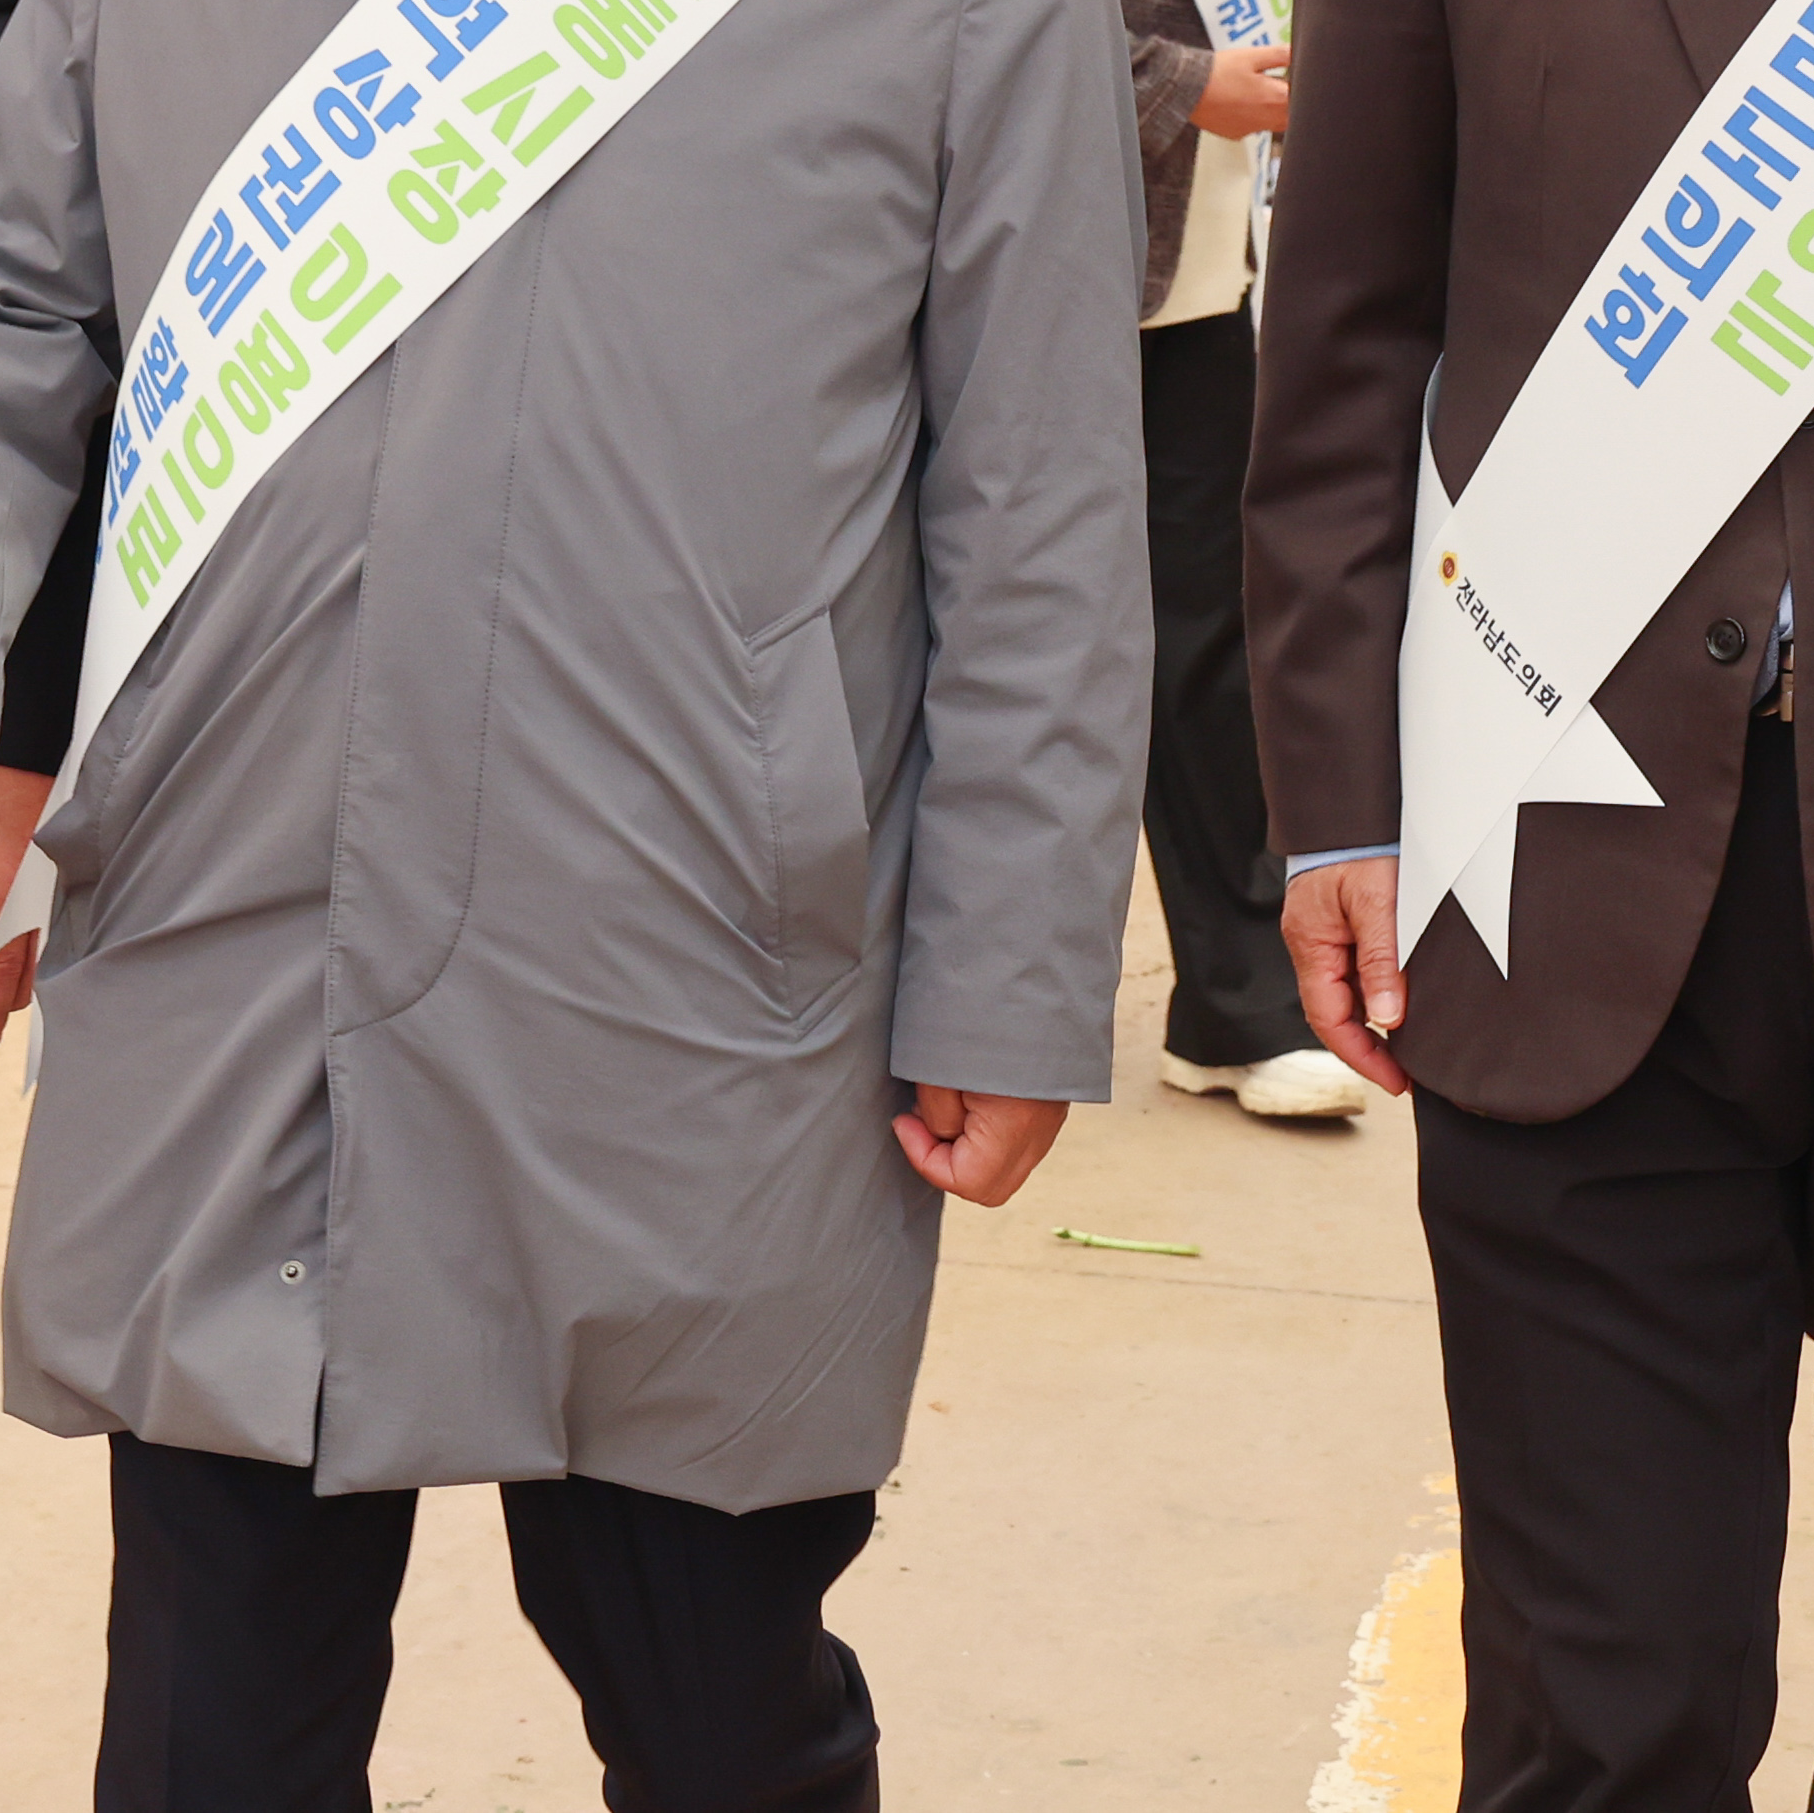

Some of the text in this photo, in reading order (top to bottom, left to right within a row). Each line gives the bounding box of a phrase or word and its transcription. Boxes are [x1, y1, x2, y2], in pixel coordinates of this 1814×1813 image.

[94, 314, 191, 568] 활력
[115, 221, 404, 609] 이용으로
[1454, 575, 1565, 719] 전라남도의회
